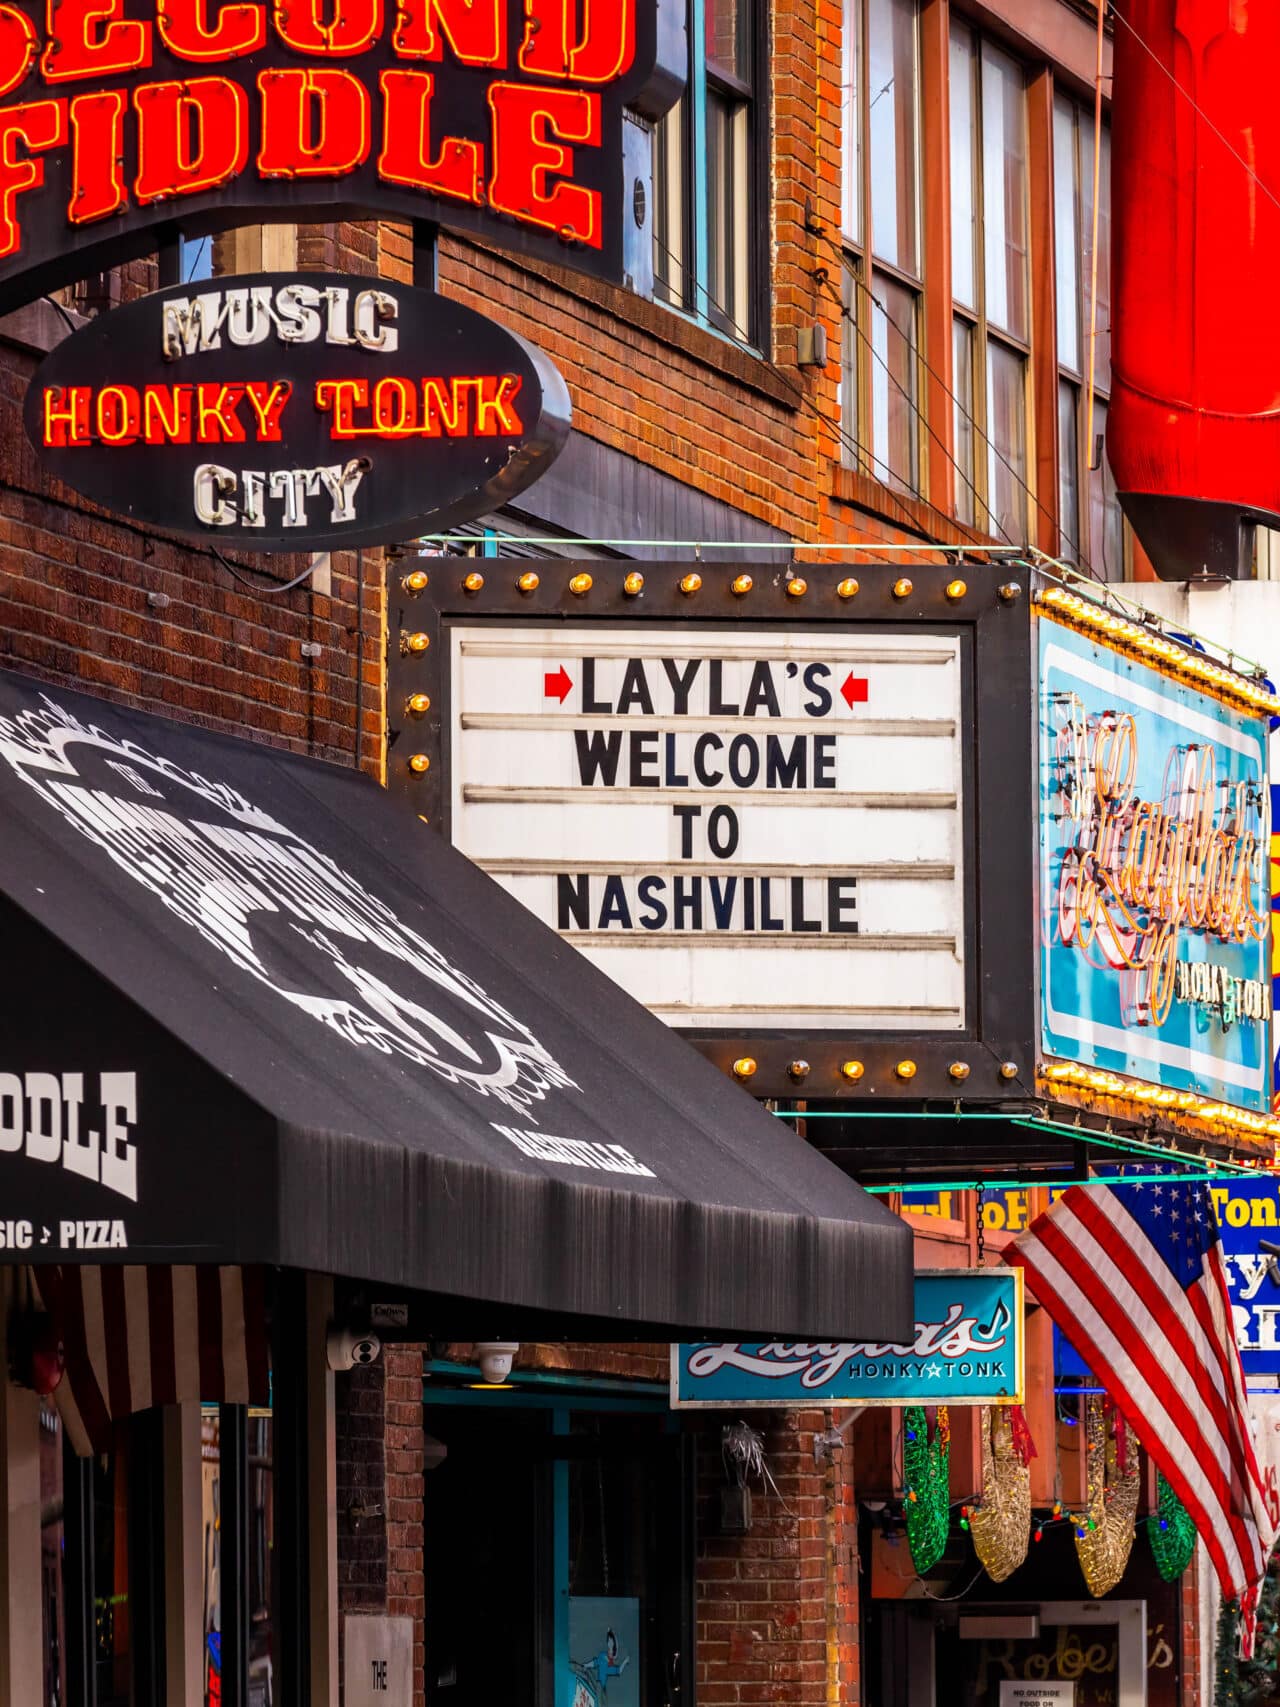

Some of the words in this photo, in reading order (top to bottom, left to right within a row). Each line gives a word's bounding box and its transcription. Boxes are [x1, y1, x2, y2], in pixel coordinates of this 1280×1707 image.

[163, 284, 399, 361] MUSIC
[43, 380, 294, 447] HONKY
[316, 373, 524, 441] TONK
[193, 457, 374, 528] CITY
[580, 656, 833, 718] LAYLA'S
[574, 730, 837, 789] WELCOME
[672, 804, 740, 860] TO
[556, 874, 858, 934] NASHVILLE
[60, 1219, 128, 1249] PIZZA
[849, 1362, 926, 1379] HONKY
[945, 1360, 1007, 1378] TONK
[372, 1661, 387, 1690] THE
